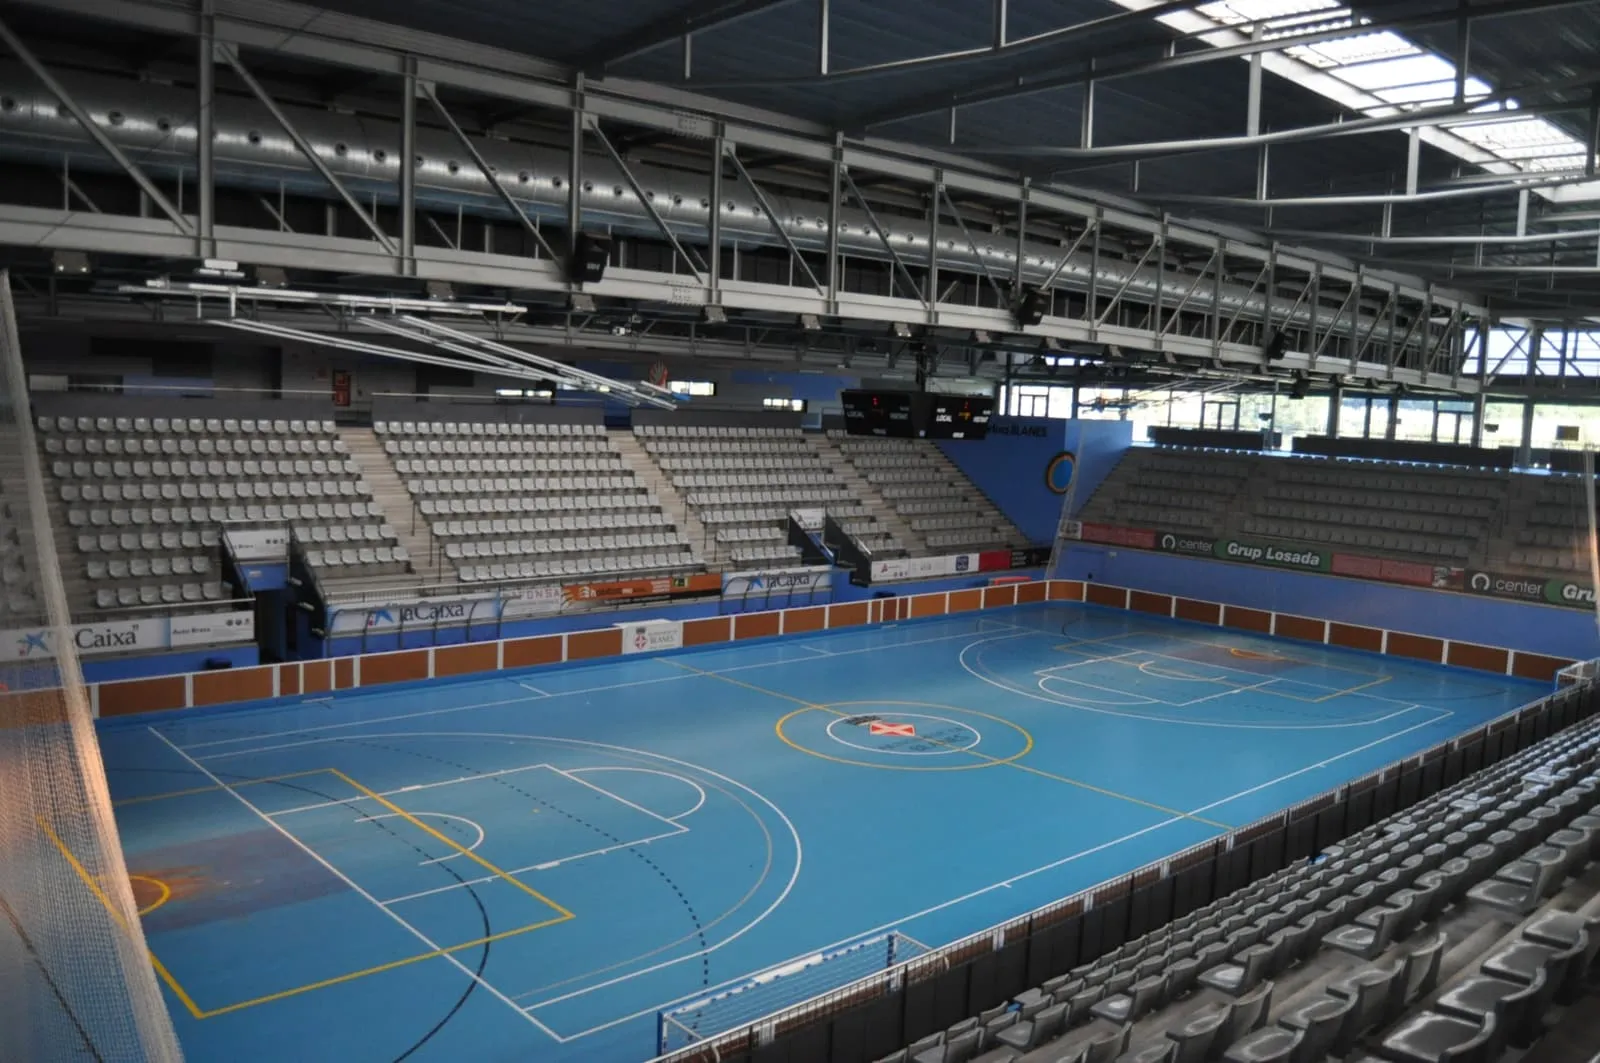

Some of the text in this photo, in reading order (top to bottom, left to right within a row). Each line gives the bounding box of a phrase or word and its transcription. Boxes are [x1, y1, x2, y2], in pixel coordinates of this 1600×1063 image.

[1179, 539, 1213, 551] center
[1227, 542, 1320, 566] Grup Losada
[1495, 579, 1542, 594] center
[1563, 584, 1596, 602] Gru
